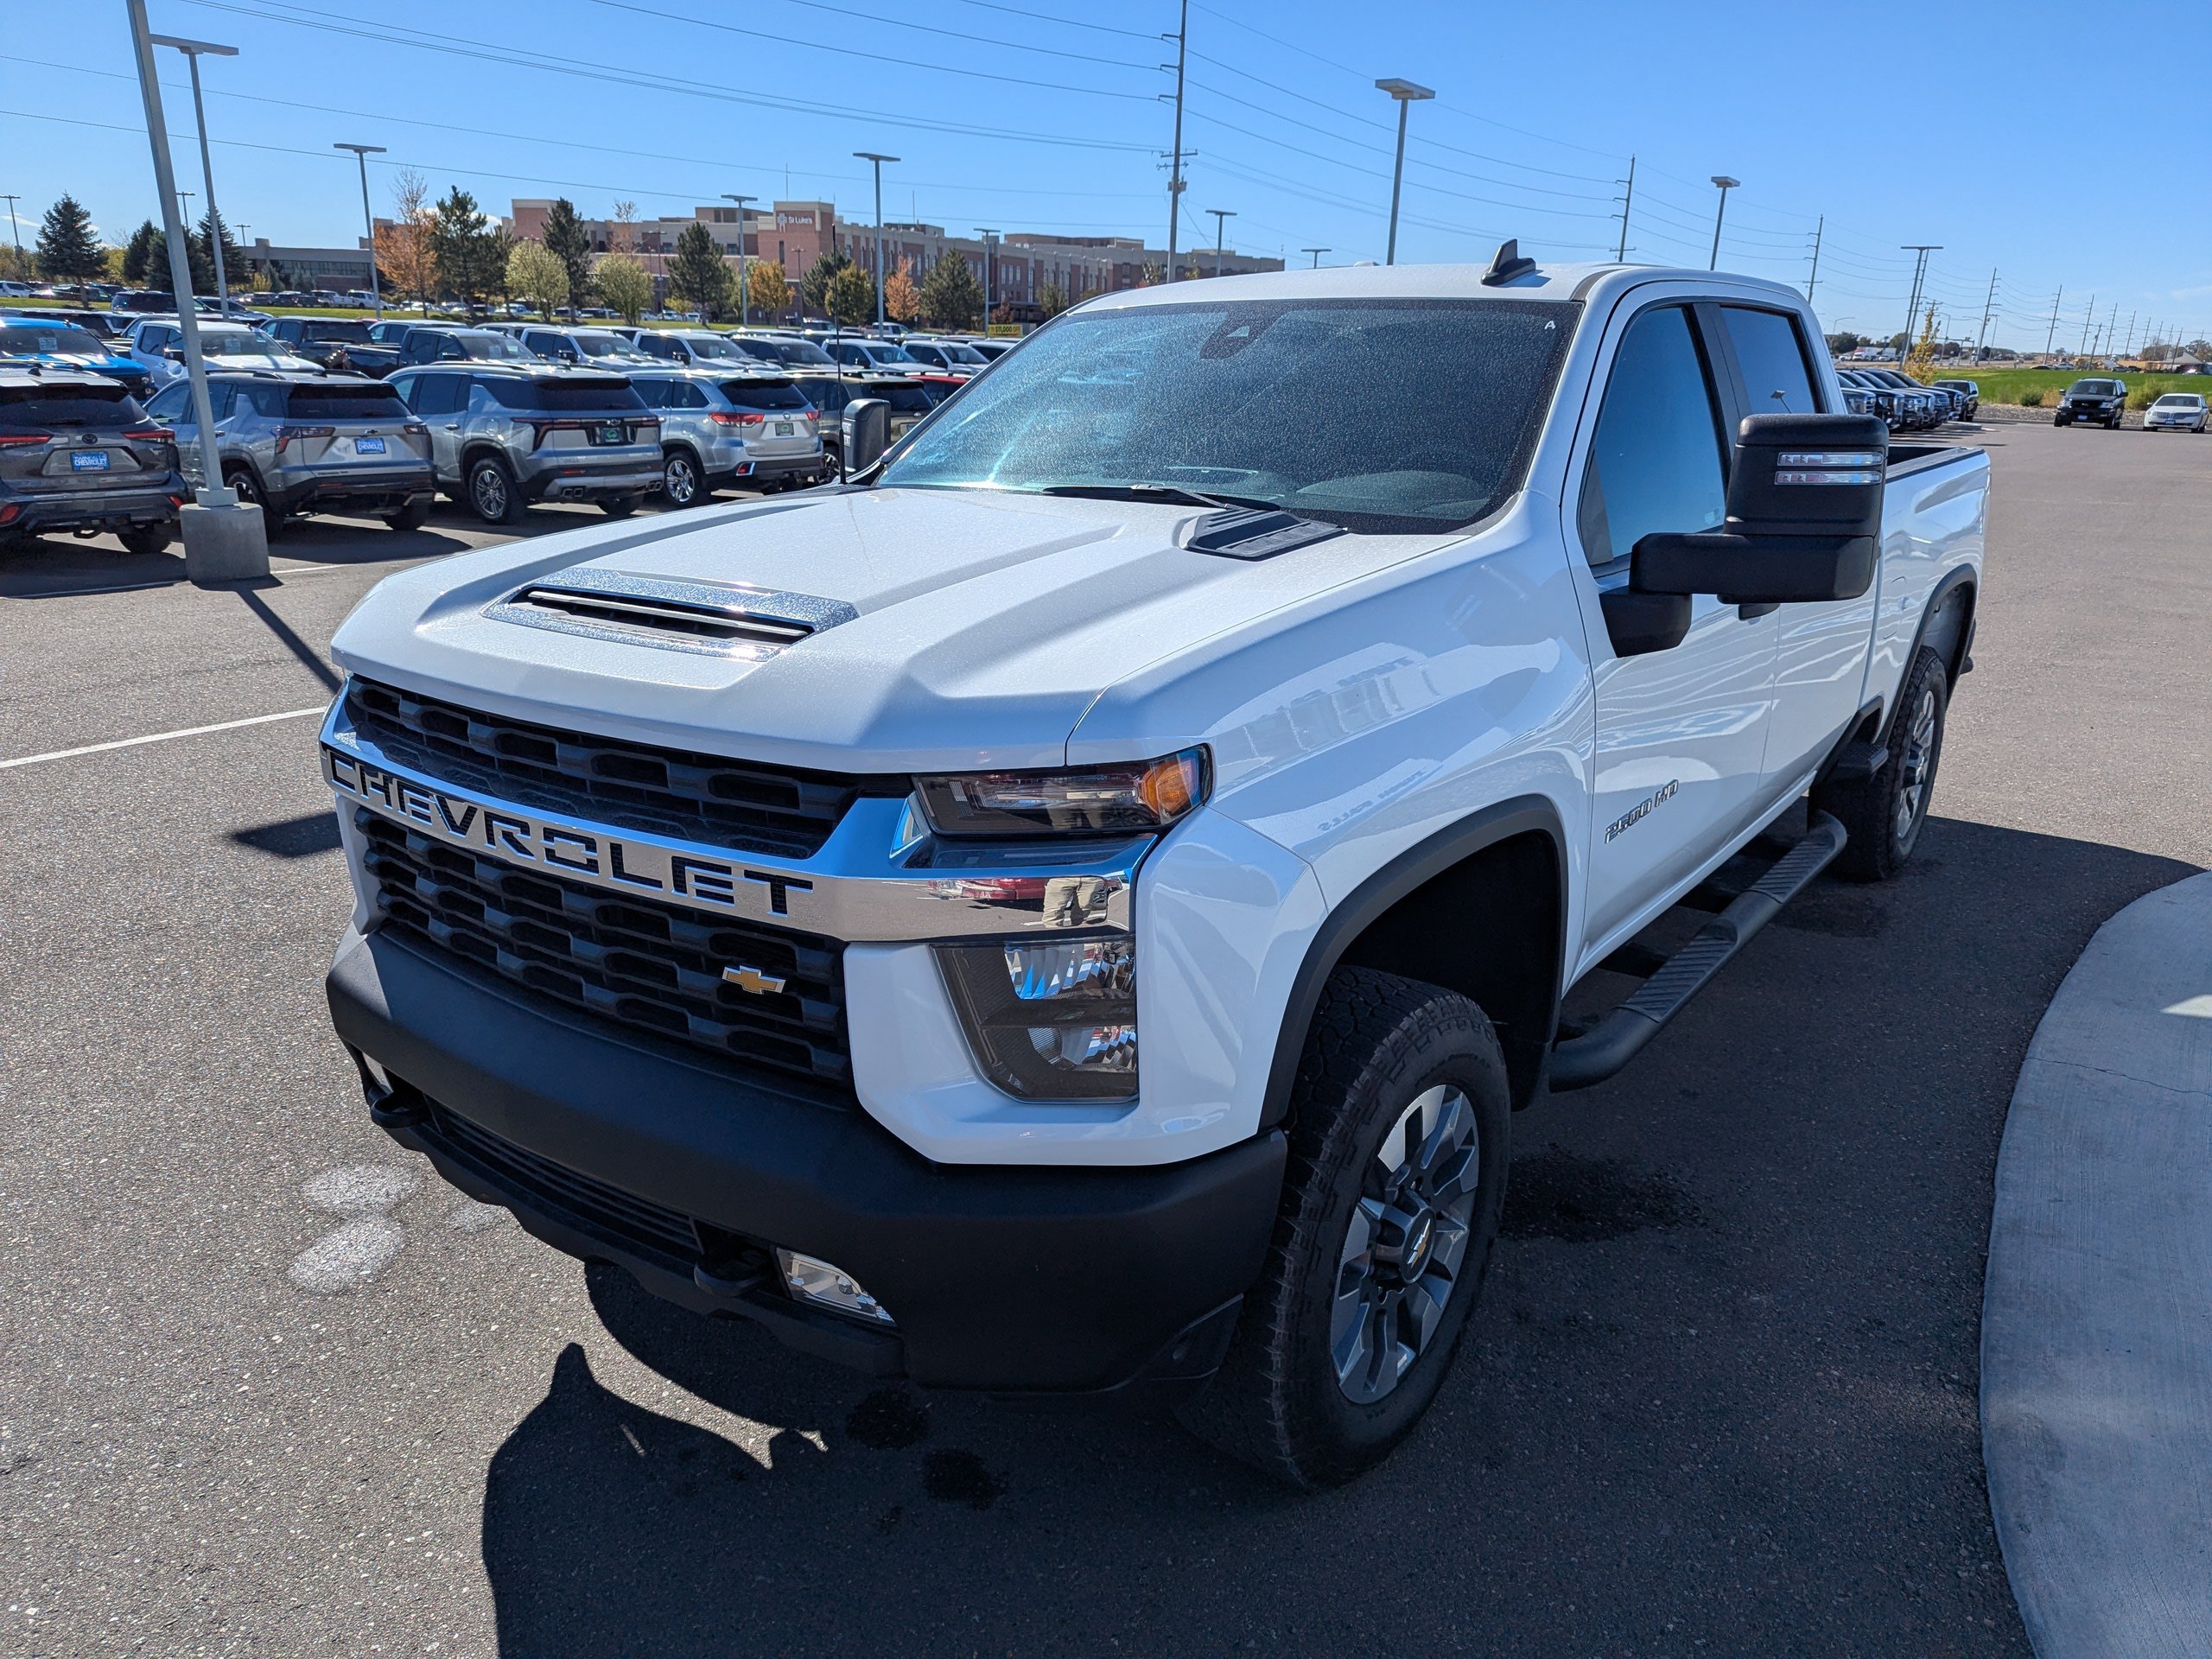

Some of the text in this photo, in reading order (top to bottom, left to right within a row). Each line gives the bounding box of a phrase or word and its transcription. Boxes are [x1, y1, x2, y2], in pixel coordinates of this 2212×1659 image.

[1544, 320, 1556, 330] A
[328, 750, 814, 918] CHEVROLET
[1605, 779, 1679, 844] 2500 HD
